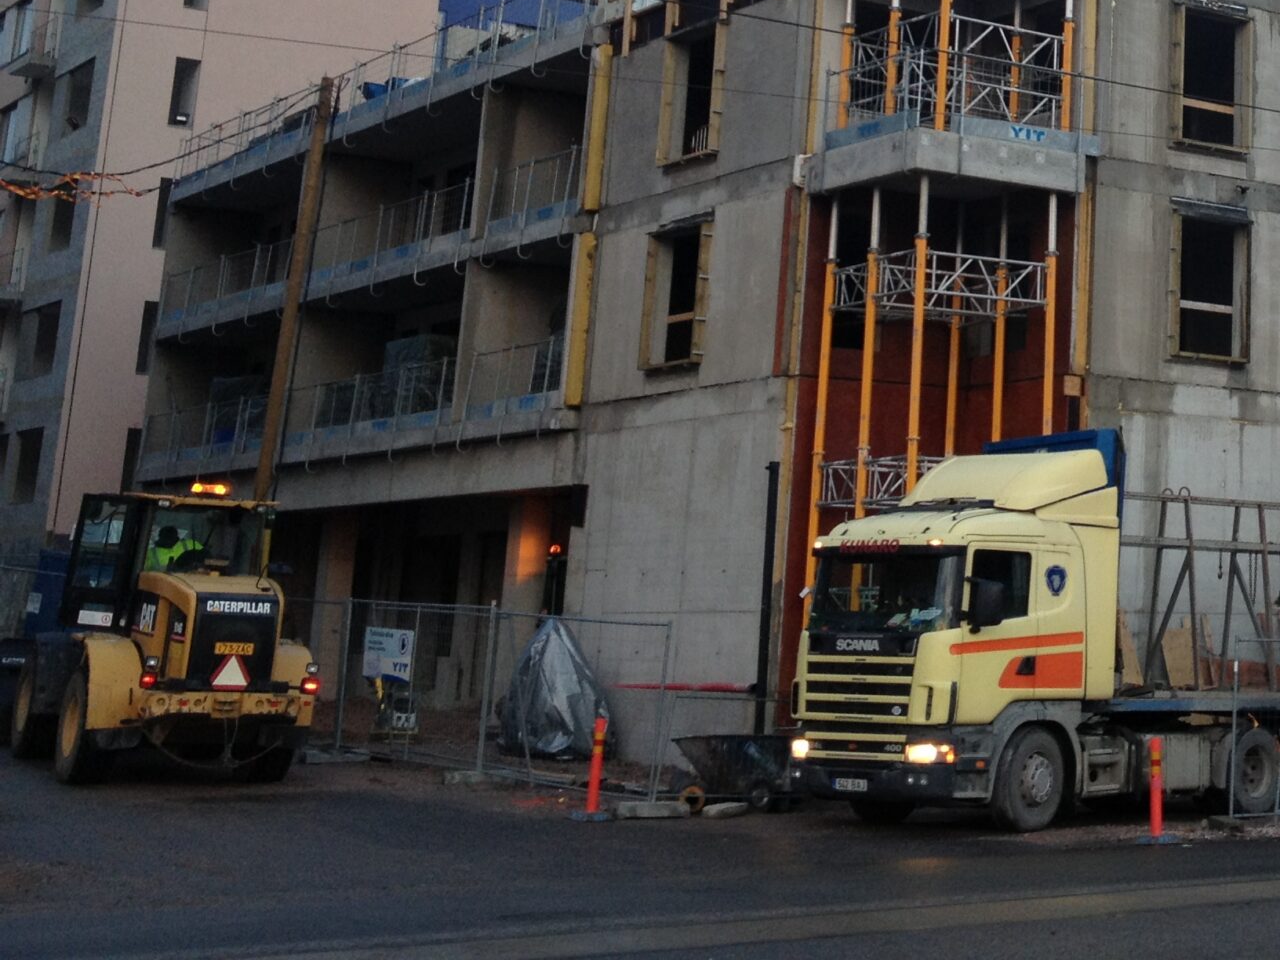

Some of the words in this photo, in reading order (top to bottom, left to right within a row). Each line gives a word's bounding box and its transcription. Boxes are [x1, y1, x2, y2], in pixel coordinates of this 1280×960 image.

[1011, 125, 1047, 142] YIT
[206, 599, 271, 615] CATERPILLAR
[139, 602, 157, 633] CAT
[836, 638, 880, 652] SCANIA
[392, 661, 409, 673] YIT
[884, 743, 902, 752] 400
